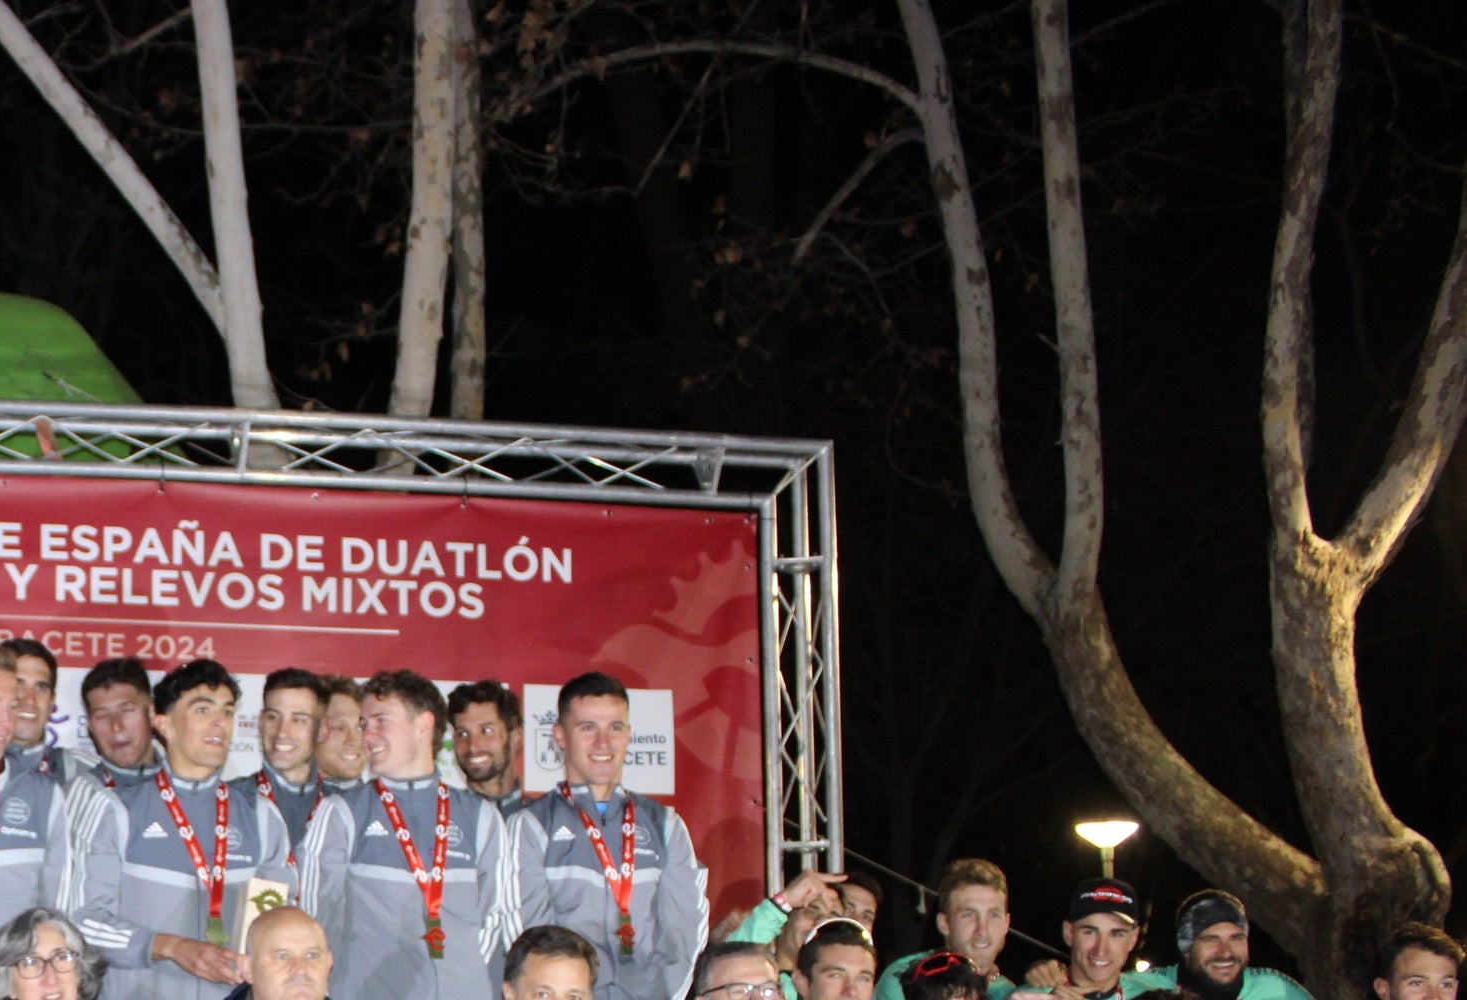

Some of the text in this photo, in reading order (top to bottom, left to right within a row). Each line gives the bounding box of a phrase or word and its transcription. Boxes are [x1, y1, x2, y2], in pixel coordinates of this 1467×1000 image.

[40, 519, 244, 568] ESPAÑA
[260, 533, 325, 572] DE
[341, 536, 574, 584] DUATLÓN
[4, 564, 39, 601] Y
[56, 565, 285, 612] RELEVOS
[301, 575, 485, 619] MIXTOS
[136, 634, 216, 661] 2024
